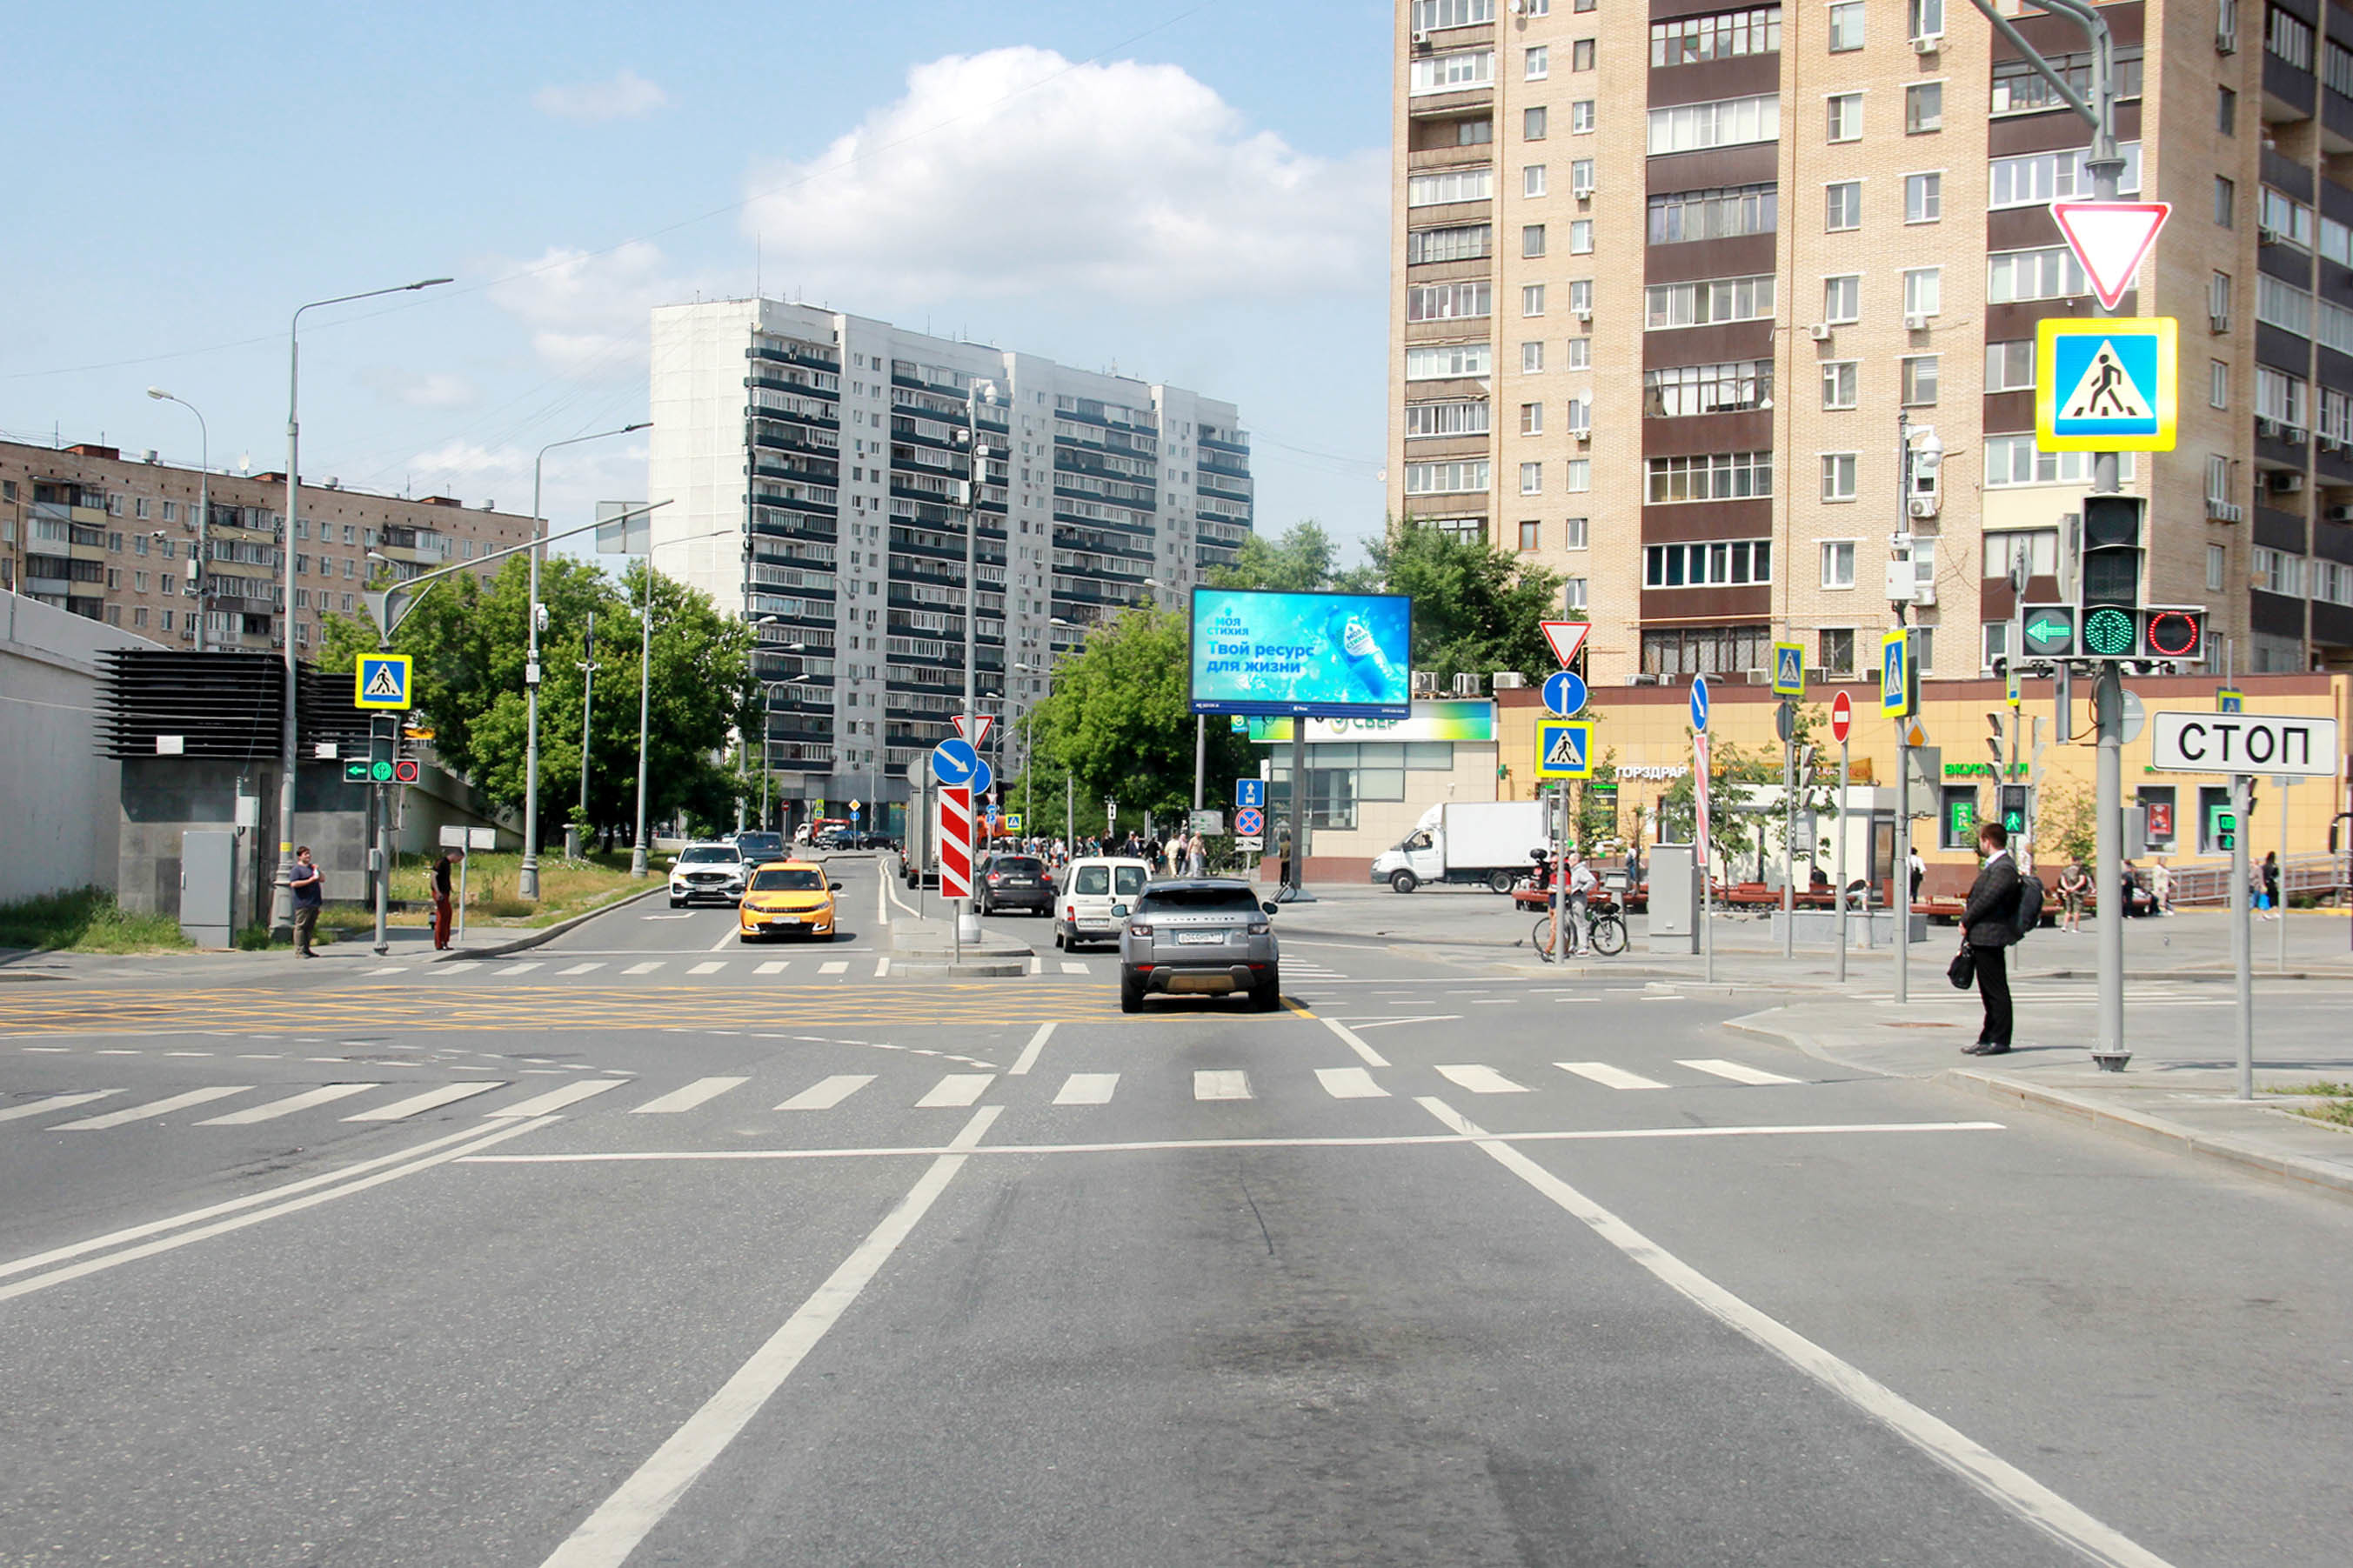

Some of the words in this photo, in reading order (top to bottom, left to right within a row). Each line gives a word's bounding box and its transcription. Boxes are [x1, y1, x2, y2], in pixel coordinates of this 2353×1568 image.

[1215, 617, 1241, 627] МОЯ
[1207, 626, 1249, 636] СТИХИЯ
[1207, 641, 1250, 655] Твой
[1255, 644, 1315, 659] ресурс
[1207, 660, 1240, 674] для
[1245, 661, 1302, 673] жизни
[2178, 722, 2310, 765] СТОП
